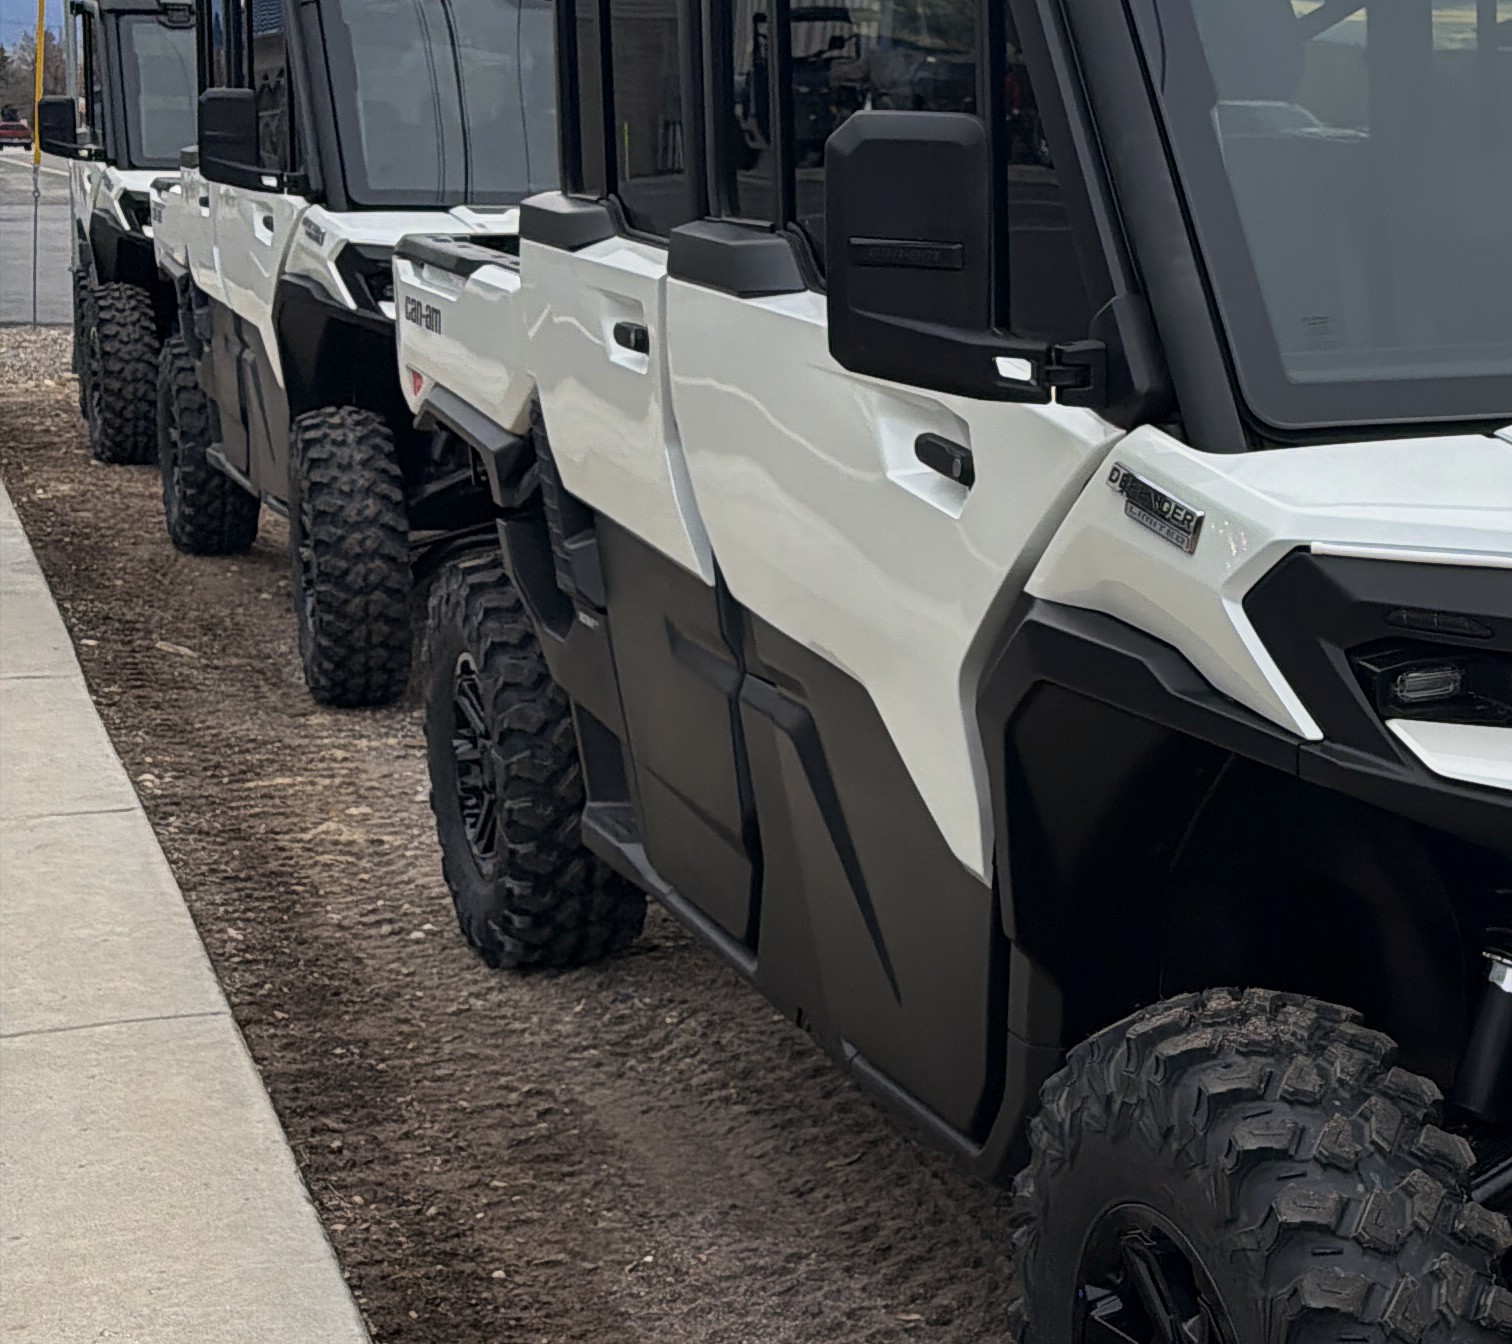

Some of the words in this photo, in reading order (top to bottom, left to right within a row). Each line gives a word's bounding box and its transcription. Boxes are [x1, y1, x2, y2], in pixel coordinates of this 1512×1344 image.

[405, 296, 441, 335] can-am
[1108, 466, 1195, 530] DENDER
[1129, 506, 1186, 545] LIMITED
